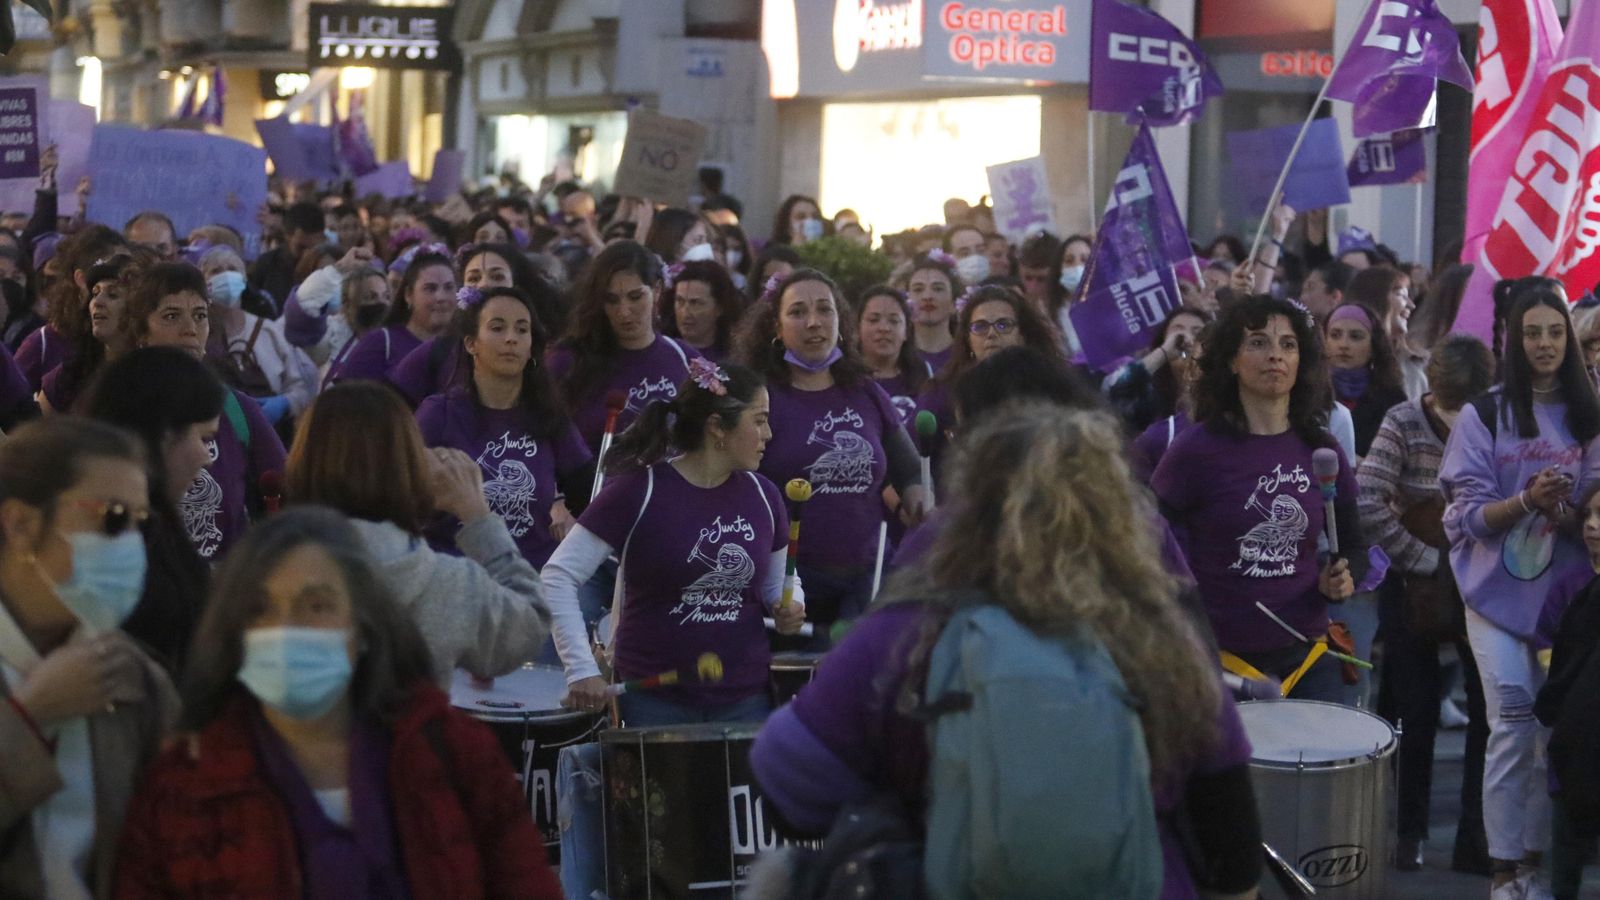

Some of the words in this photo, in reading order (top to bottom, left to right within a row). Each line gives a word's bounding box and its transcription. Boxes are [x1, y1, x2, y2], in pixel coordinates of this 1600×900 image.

[942, 2, 1067, 36] General
[951, 34, 1056, 71] Optica
[639, 146, 679, 171] NO
[1303, 851, 1363, 878] OZZI
